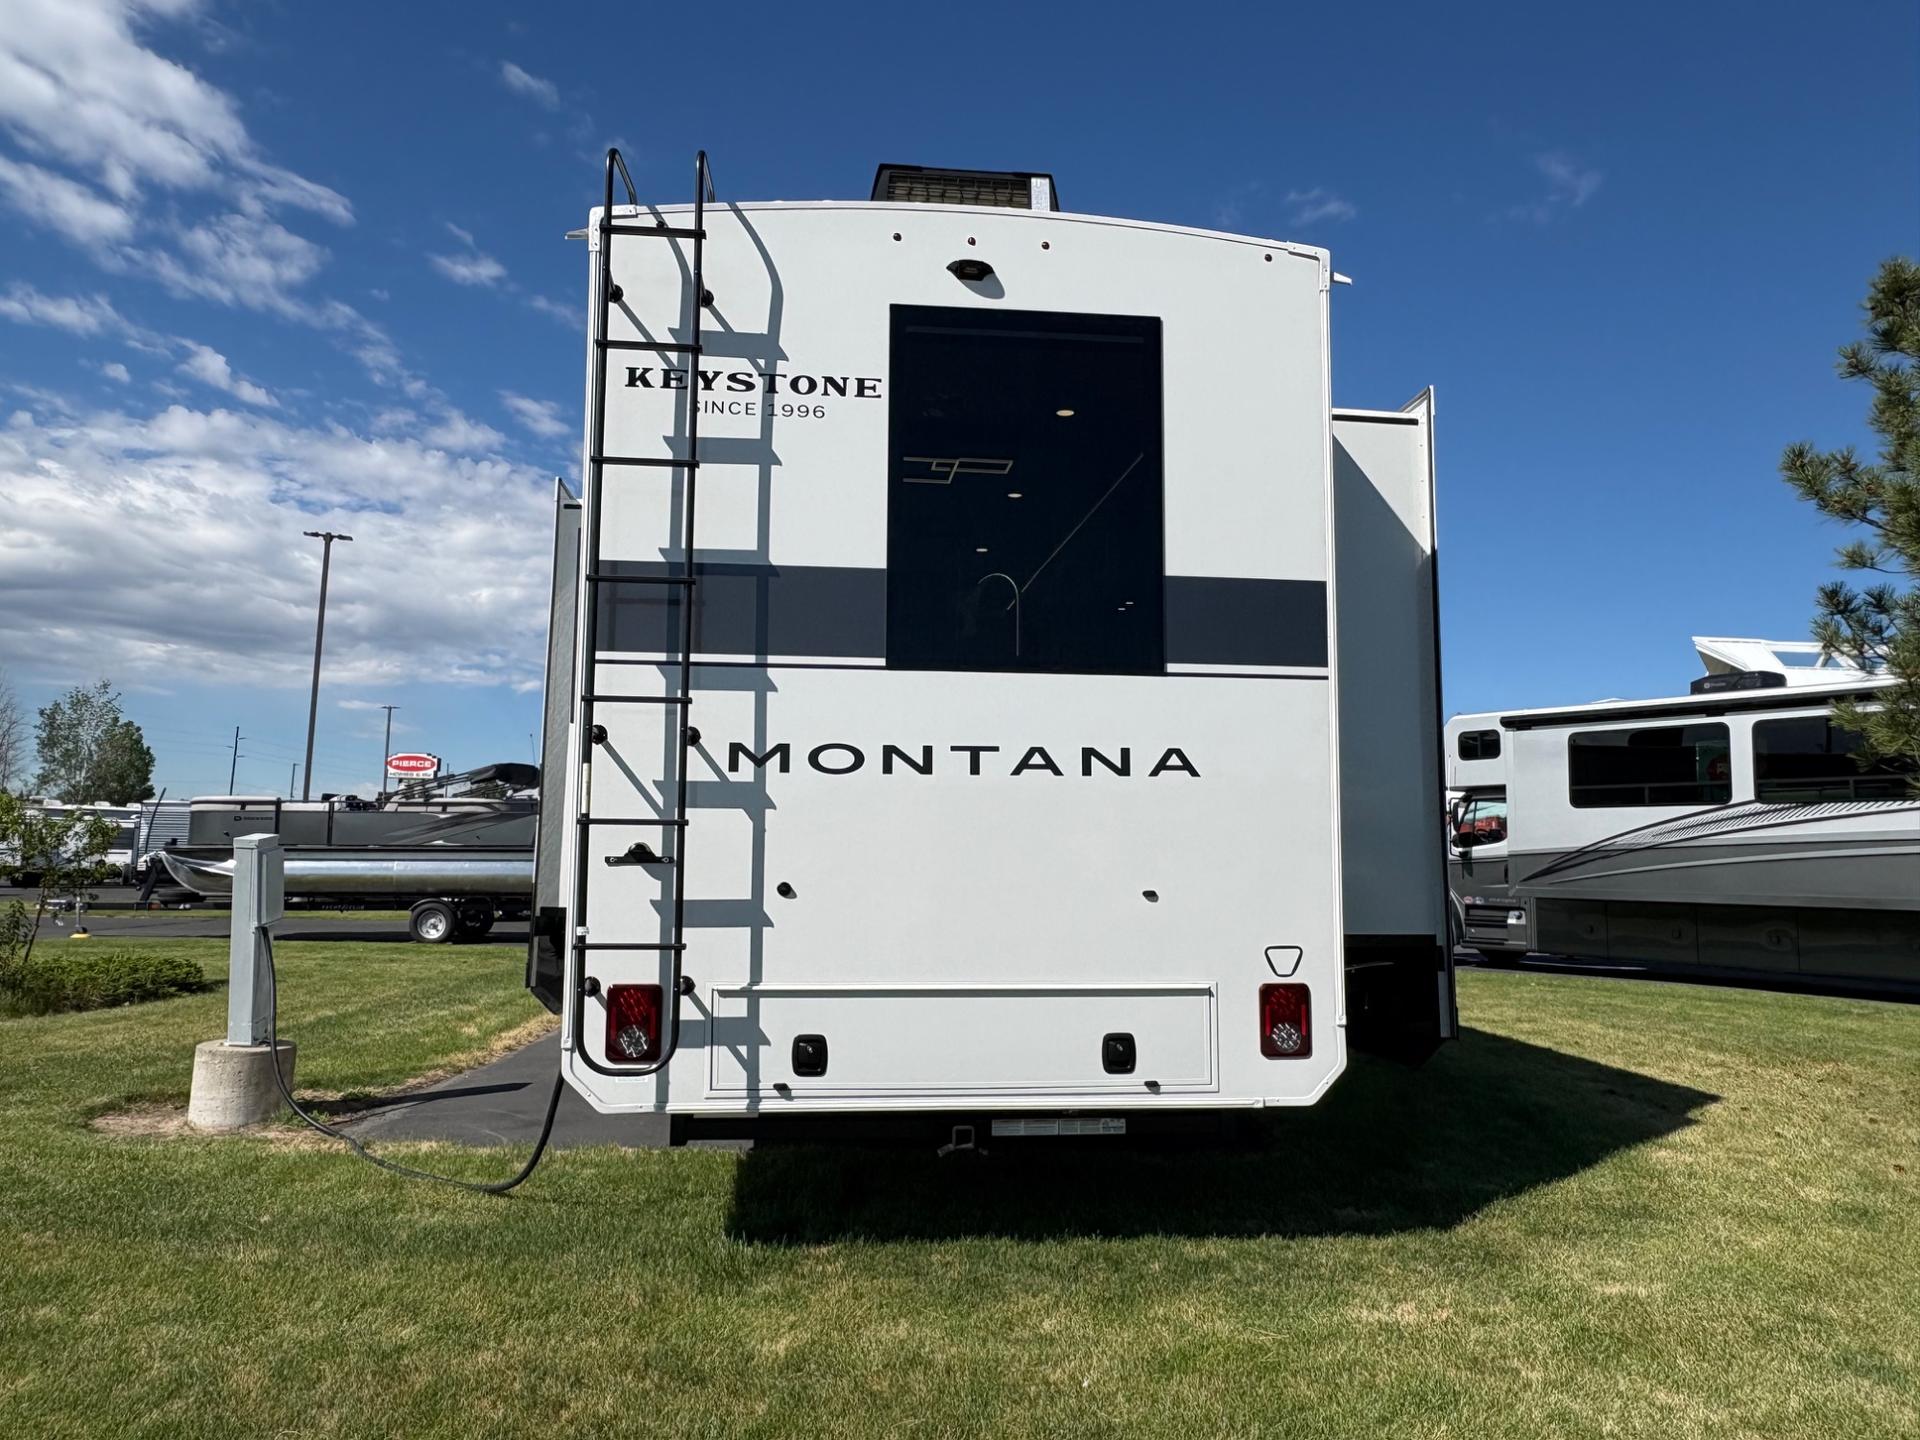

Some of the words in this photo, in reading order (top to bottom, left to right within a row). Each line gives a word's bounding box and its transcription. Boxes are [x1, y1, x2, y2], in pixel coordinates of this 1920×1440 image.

[624, 366, 882, 399] KEYSTONE
[767, 403, 826, 419] 1996
[391, 759, 432, 768] PIERCE
[728, 742, 1201, 778] MONTANA
